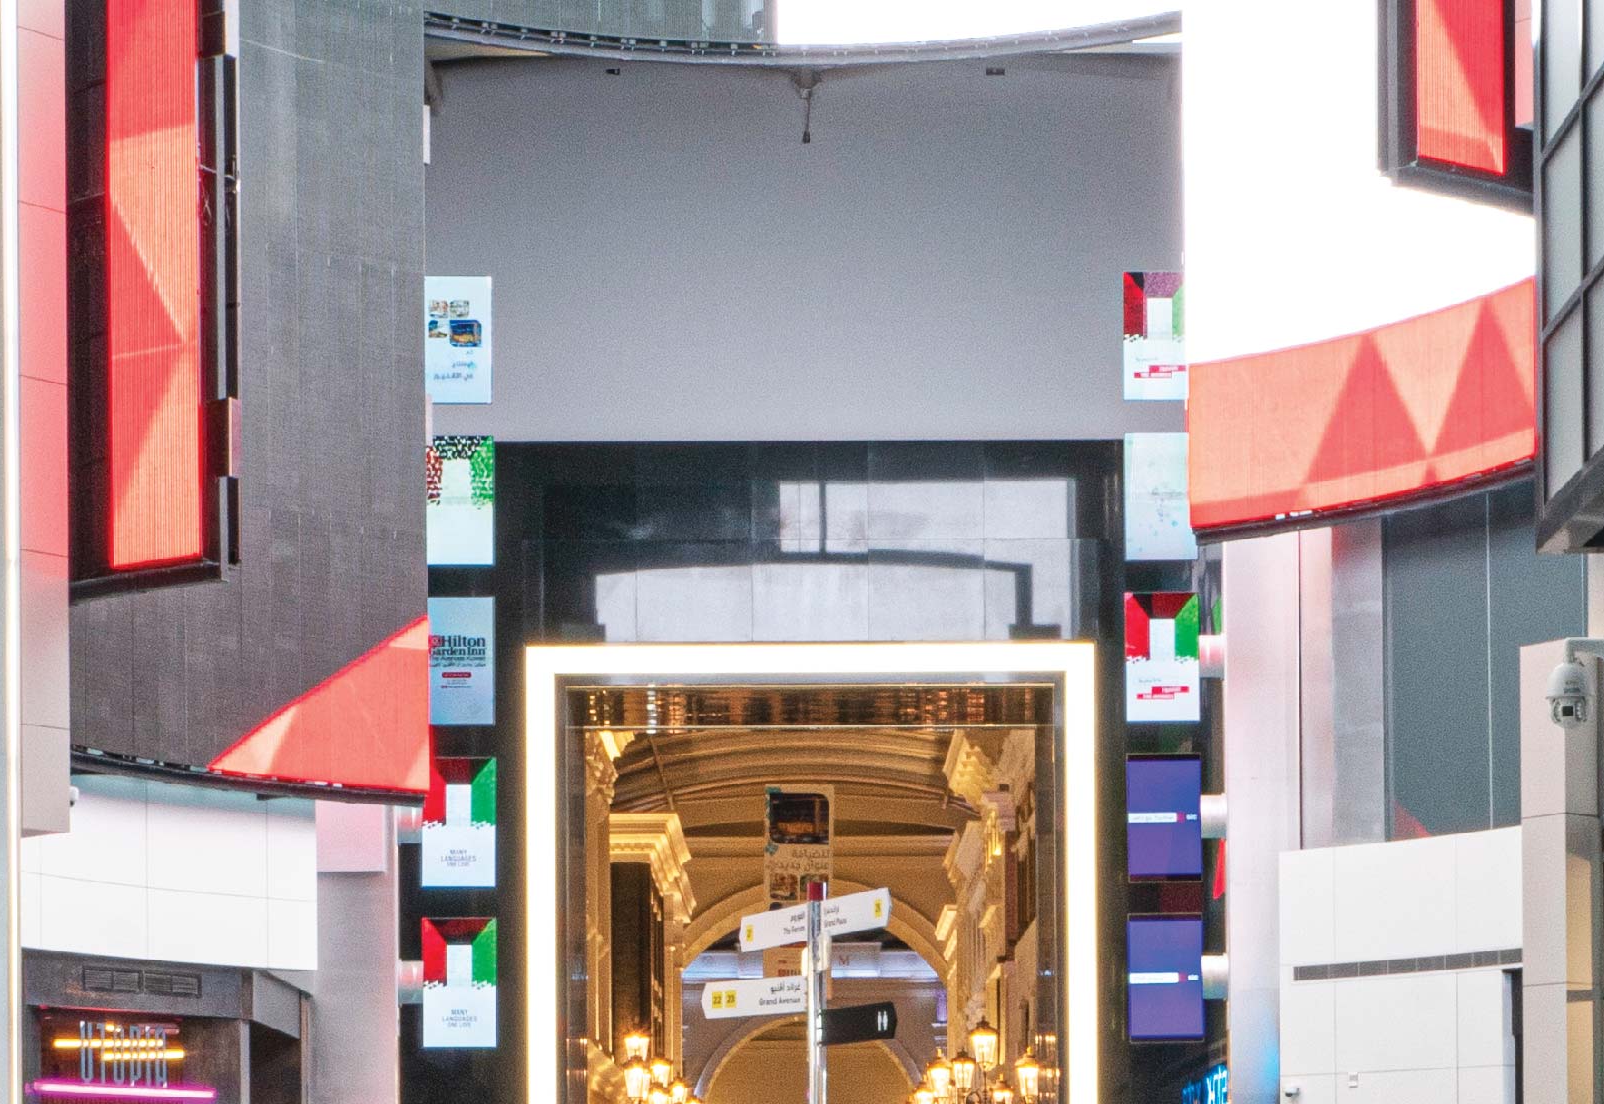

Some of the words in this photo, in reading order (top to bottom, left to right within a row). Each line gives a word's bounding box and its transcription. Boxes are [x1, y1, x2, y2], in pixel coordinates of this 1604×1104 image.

[442, 635, 486, 647] Hilton
[759, 997, 777, 1006] Grand
[79, 1020, 169, 1088] UTOPIA
